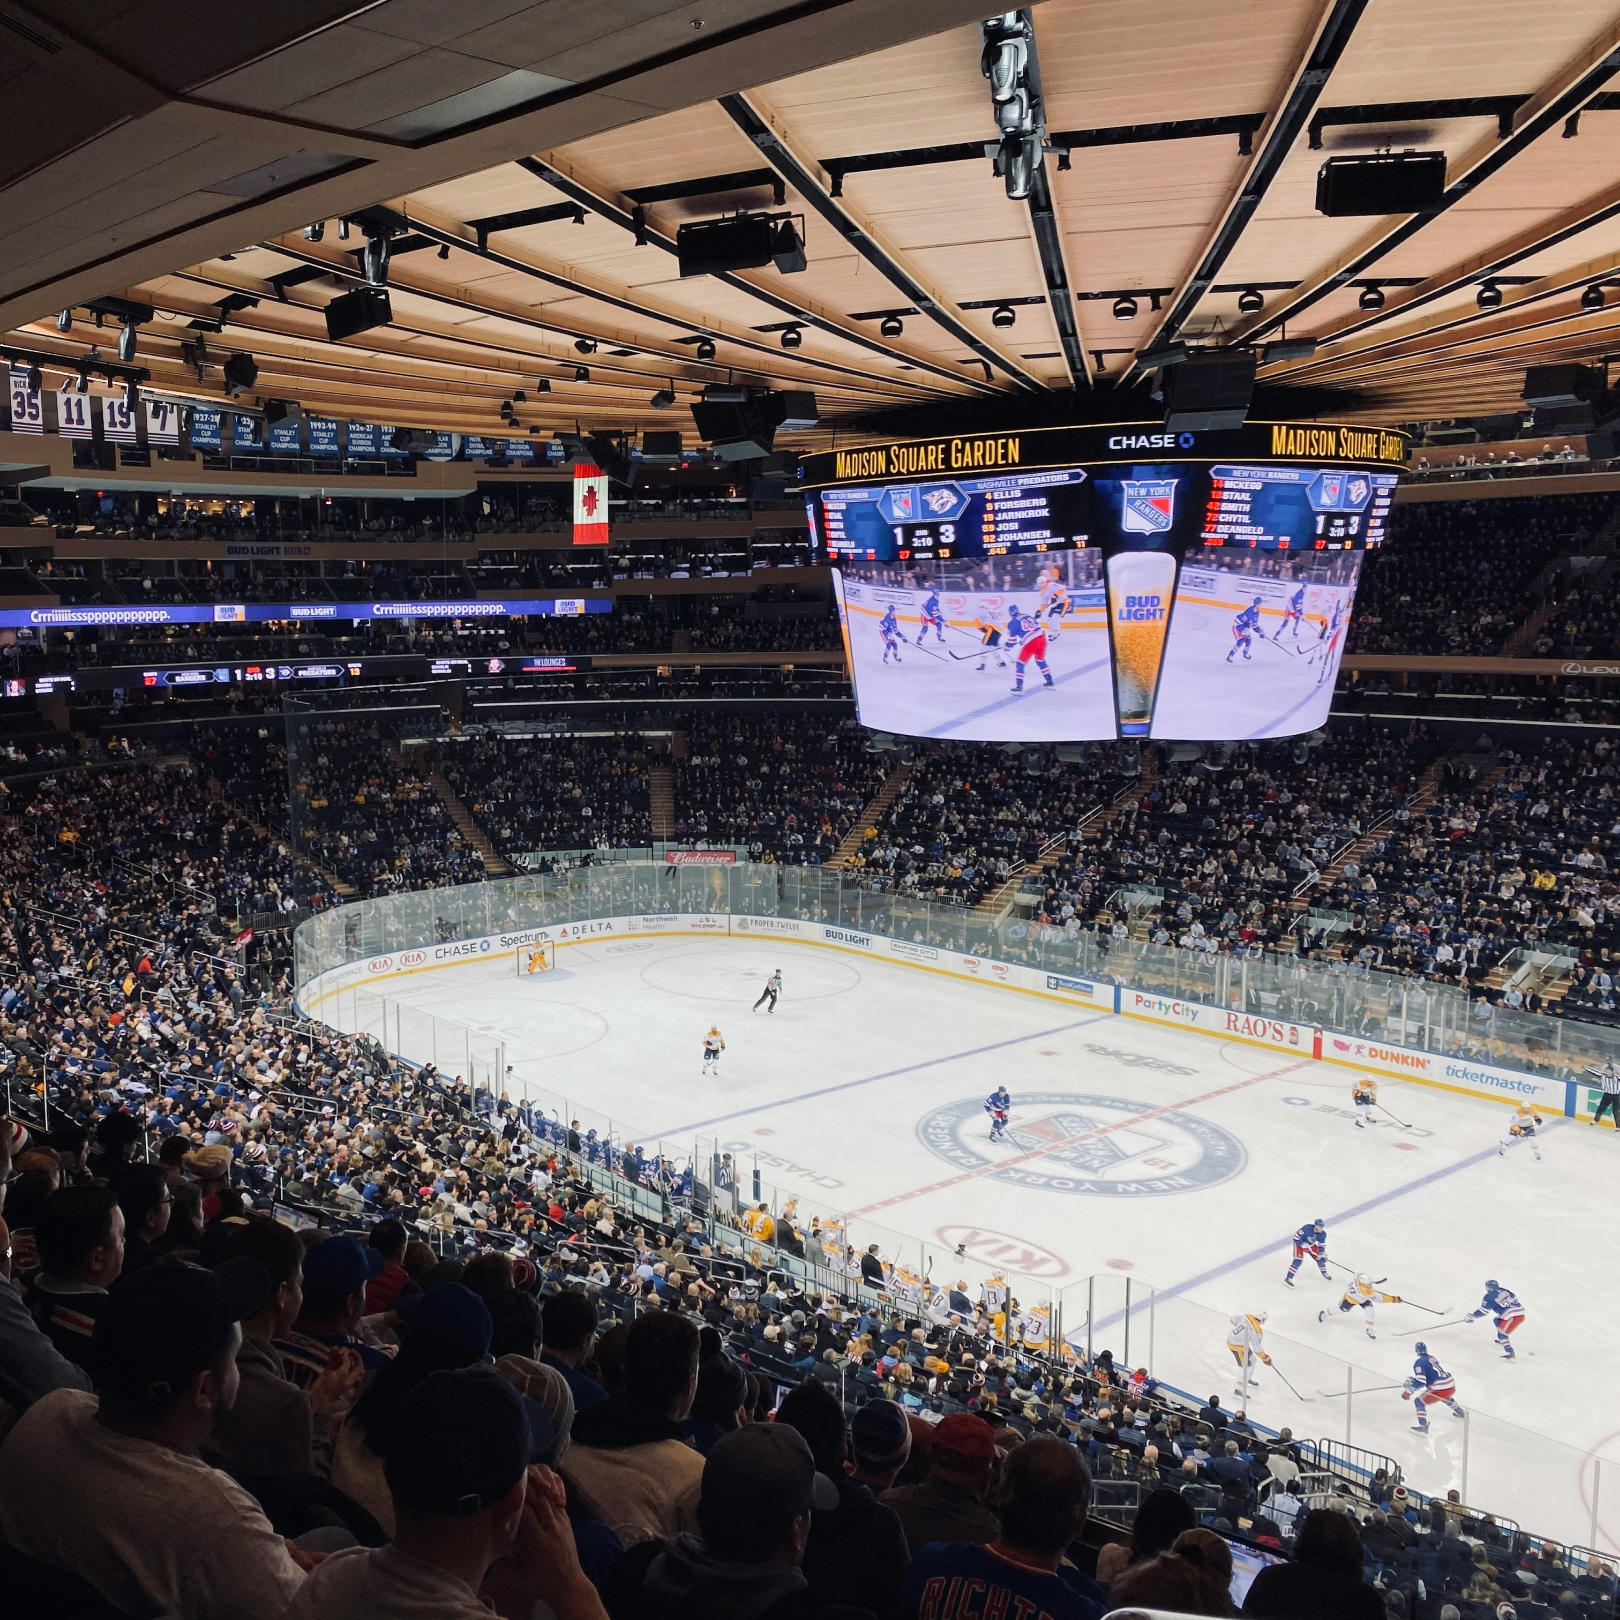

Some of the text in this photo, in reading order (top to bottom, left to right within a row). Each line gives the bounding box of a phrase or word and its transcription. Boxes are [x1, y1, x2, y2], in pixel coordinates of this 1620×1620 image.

[12, 390, 40, 421] 35
[63, 397, 86, 426] 11
[107, 401, 132, 429] 19
[158, 404, 169, 432] 7
[195, 423, 217, 431] STANLEY
[310, 421, 337, 431] 1993-94
[192, 436, 221, 445] CHAMPIONS
[271, 441, 300, 450] CHAMPIONS
[1109, 434, 1176, 450] CHASE
[1272, 425, 1336, 456] MADISON
[1339, 428, 1378, 460] SQUARE
[836, 437, 1020, 478] MADISON SQUARE GARDEN
[977, 473, 1070, 489] NASHVILLE PREDATORS
[1232, 469, 1300, 480] NEW YORK RANGERS
[1128, 486, 1171, 497] NEW YORK
[1223, 480, 1263, 490] MCKEGG
[984, 489, 1022, 500] 4 ELLIS
[1222, 491, 1252, 501] STAAL
[994, 498, 1047, 511] FORSBERG
[1206, 501, 1251, 512] 42 SMITH
[982, 508, 1051, 522] 19 JARNKROK
[1133, 499, 1168, 527] RANGERS
[1205, 512, 1252, 523] 72 CHYTIL
[996, 522, 1019, 532] JOSI
[1204, 524, 1264, 534] 77 DEANGELO
[1315, 514, 1360, 535] 1 3
[893, 524, 956, 546] 1 3
[997, 530, 1051, 542] JOHANSEN
[911, 537, 933, 547] 3:10
[1036, 544, 1048, 552] 12
[227, 546, 250, 555] BUD
[250, 546, 281, 556] LIGHT
[898, 549, 911, 560] 27
[938, 548, 950, 558] 13
[1125, 595, 1161, 608] BUD
[292, 607, 335, 617] BUD LIGHT
[1118, 608, 1165, 621] LIGHT
[541, 658, 566, 666] LOUNGES
[234, 668, 275, 681] 1 3
[298, 669, 336, 677] PREDATORS
[349, 667, 361, 676] 13
[671, 851, 732, 864] Budweiser
[572, 922, 613, 935] DELTA
[750, 919, 800, 931] PROPER TWELVE
[500, 931, 548, 948] Spectrum
[825, 929, 871, 947] BUD LIGHT
[435, 942, 478, 959] CHASE
[893, 943, 935, 957] EMPIRE CITY
[372, 959, 389, 971] KIA
[403, 952, 423, 965] KIA
[964, 958, 977, 966] CDW
[992, 964, 1005, 972] CDW
[324, 966, 363, 986] SQUARESPACE
[1225, 1011, 1284, 1042] RAO'S
[1368, 1046, 1431, 1069] DUNKIN'
[1445, 1064, 1540, 1095] ticketmaster
[927, 1114, 987, 1166] RANGERS
[746, 1149, 846, 1190] CHASE
[1004, 1168, 1193, 1193] NEW YORK
[957, 1229, 1054, 1273] KIA
[932, 1294, 944, 1307] 8
[987, 1290, 998, 1305] 13
[1027, 1317, 1042, 1335] 23
[919, 1577, 1055, 1620] RICHT
